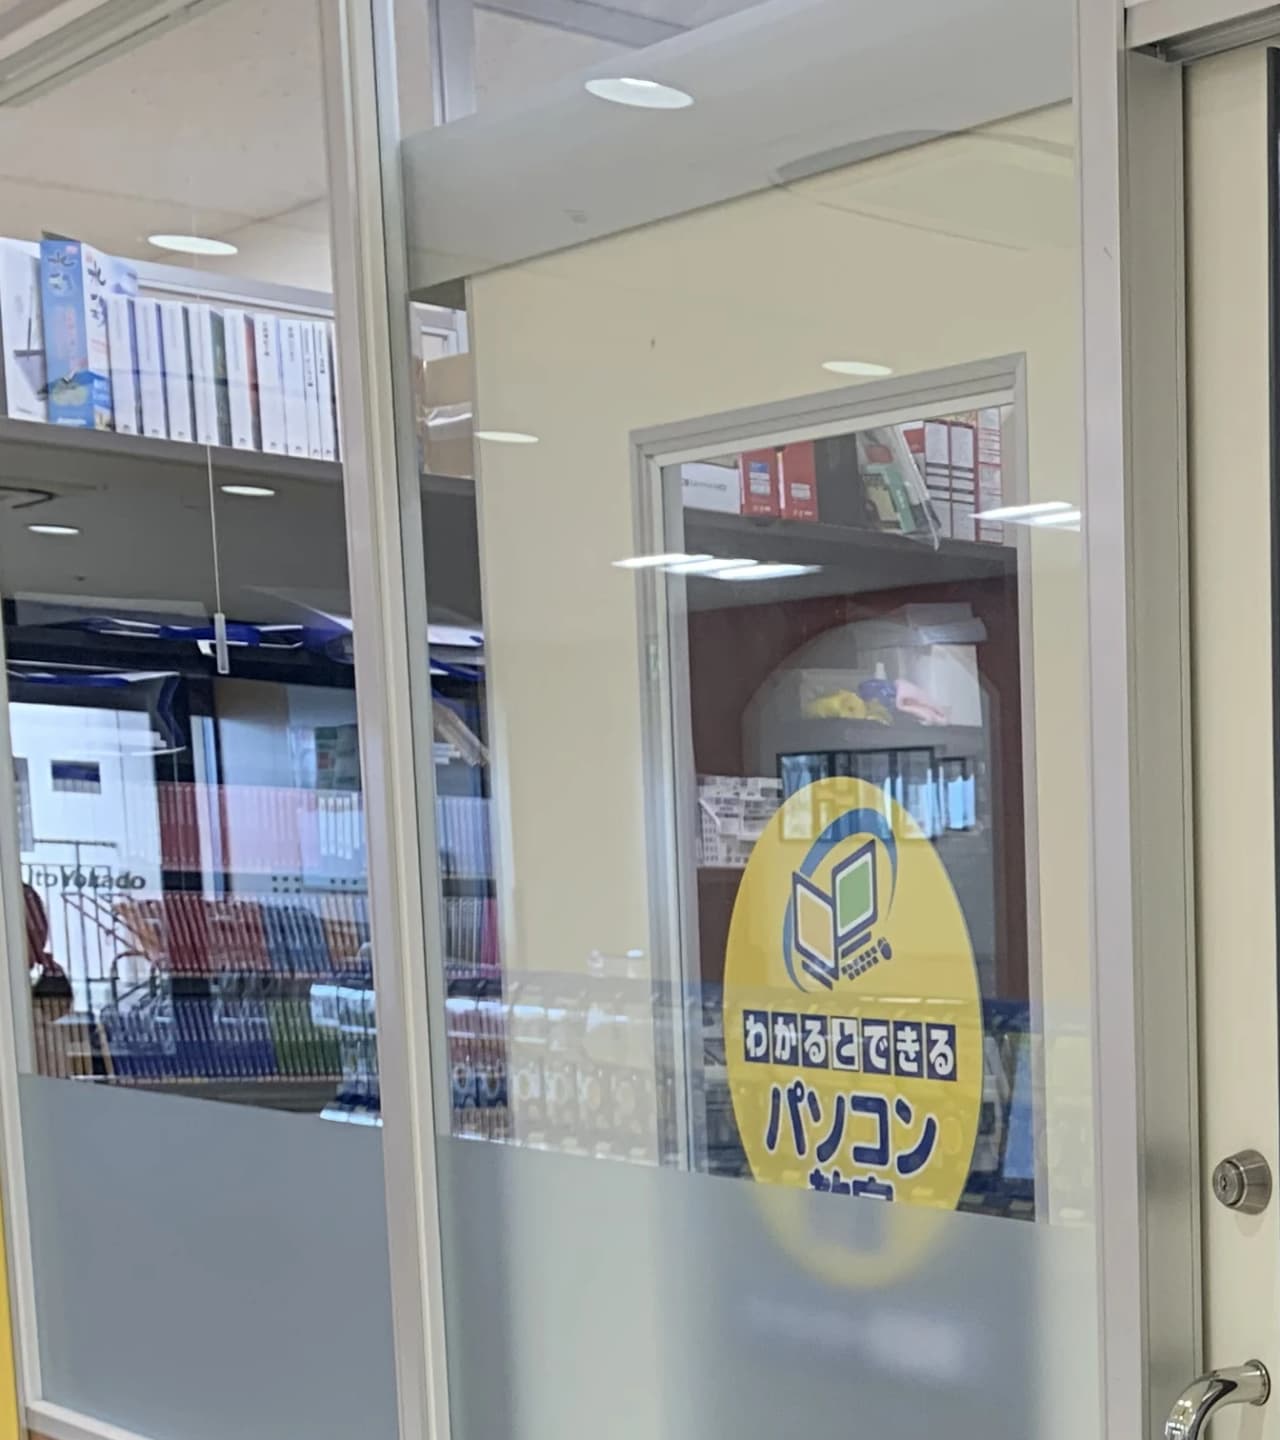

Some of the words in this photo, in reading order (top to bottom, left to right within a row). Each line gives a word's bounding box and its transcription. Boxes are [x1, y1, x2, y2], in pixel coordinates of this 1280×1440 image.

[744, 1010, 957, 1081] わかるとできる
[766, 1079, 938, 1177] パソコン
